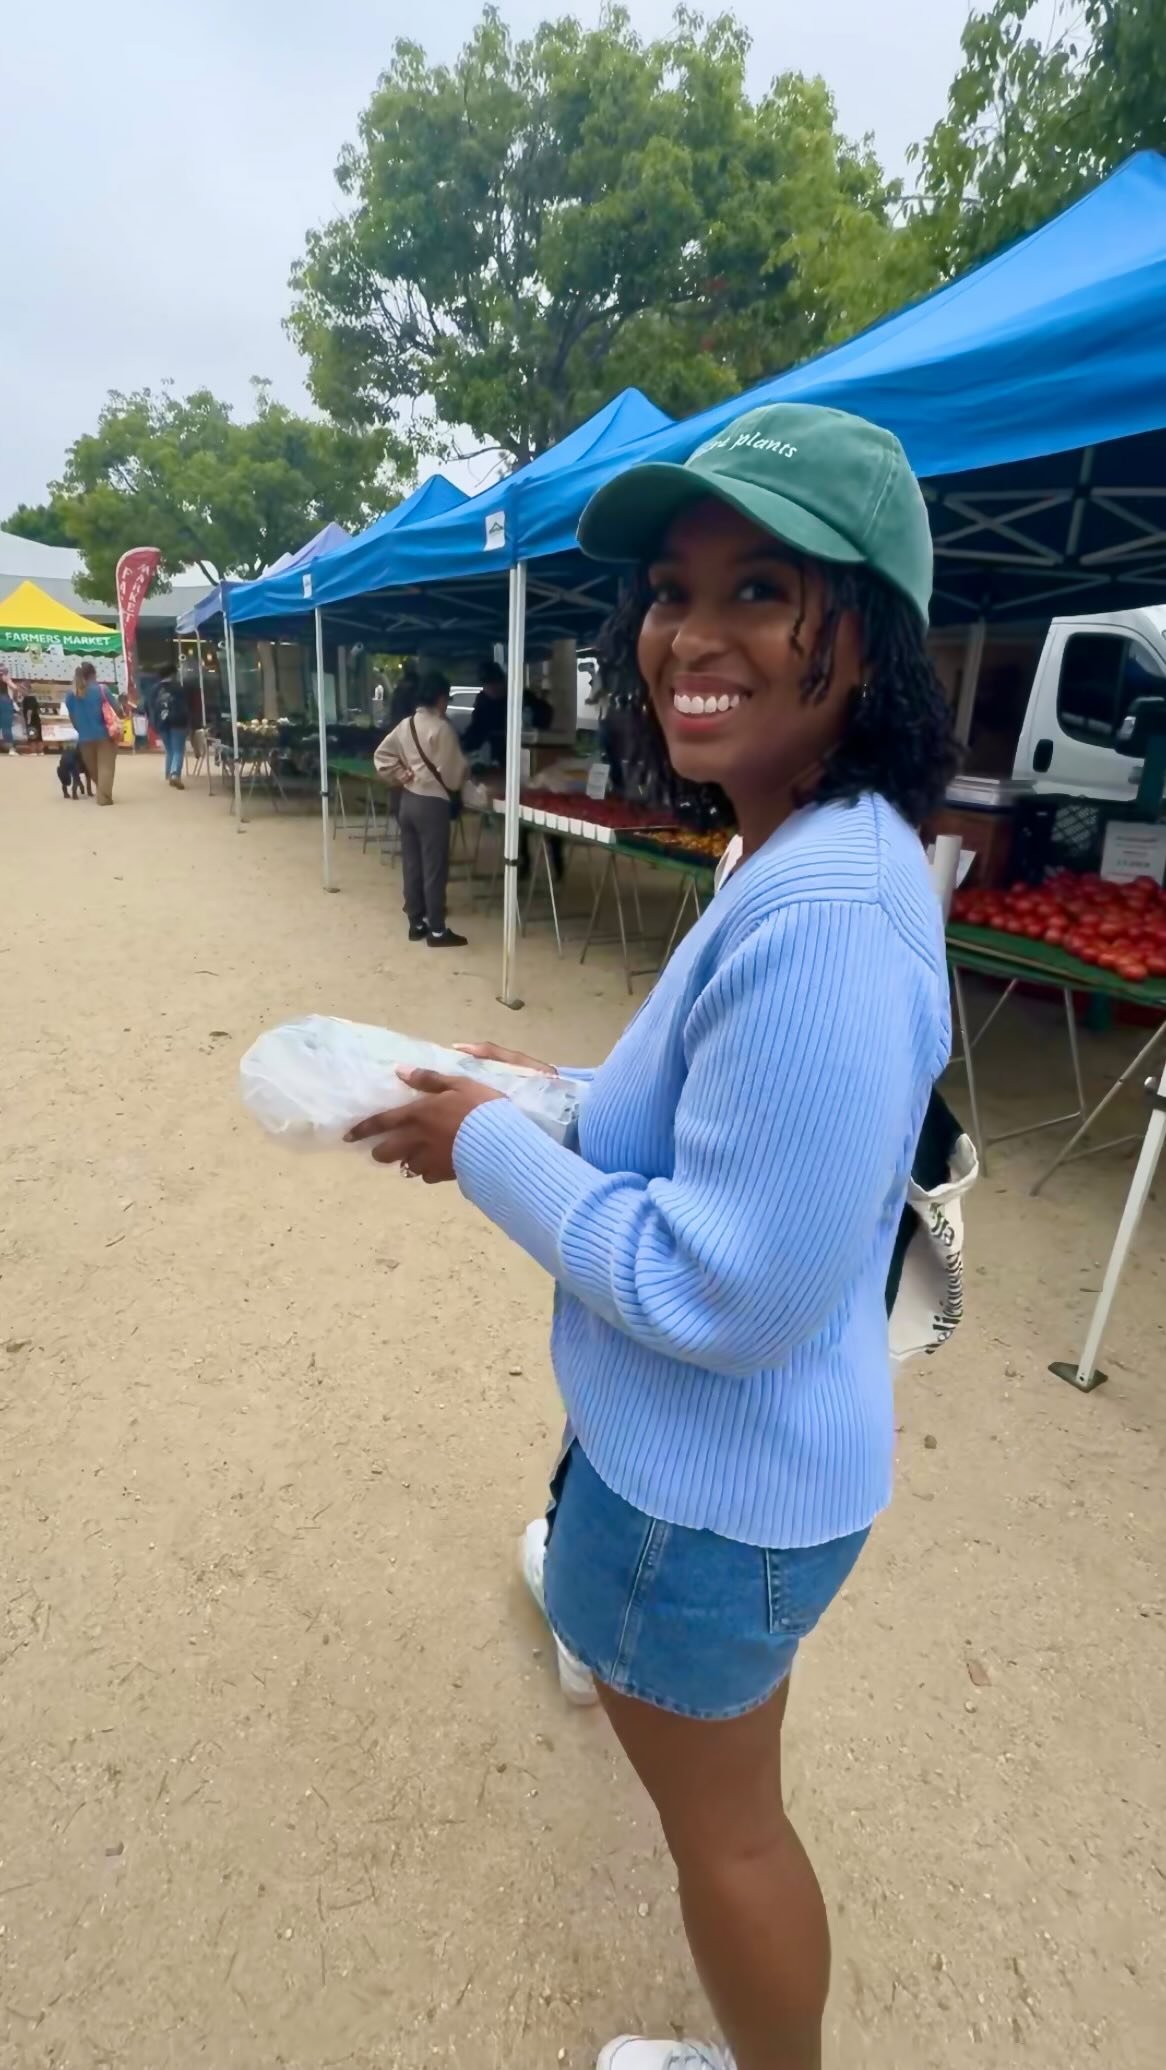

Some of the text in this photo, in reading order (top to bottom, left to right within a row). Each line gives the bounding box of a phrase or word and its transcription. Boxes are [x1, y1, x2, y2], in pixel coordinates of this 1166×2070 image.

[728, 432, 797, 458] plants
[5, 632, 111, 646] FARMERS MARKET
